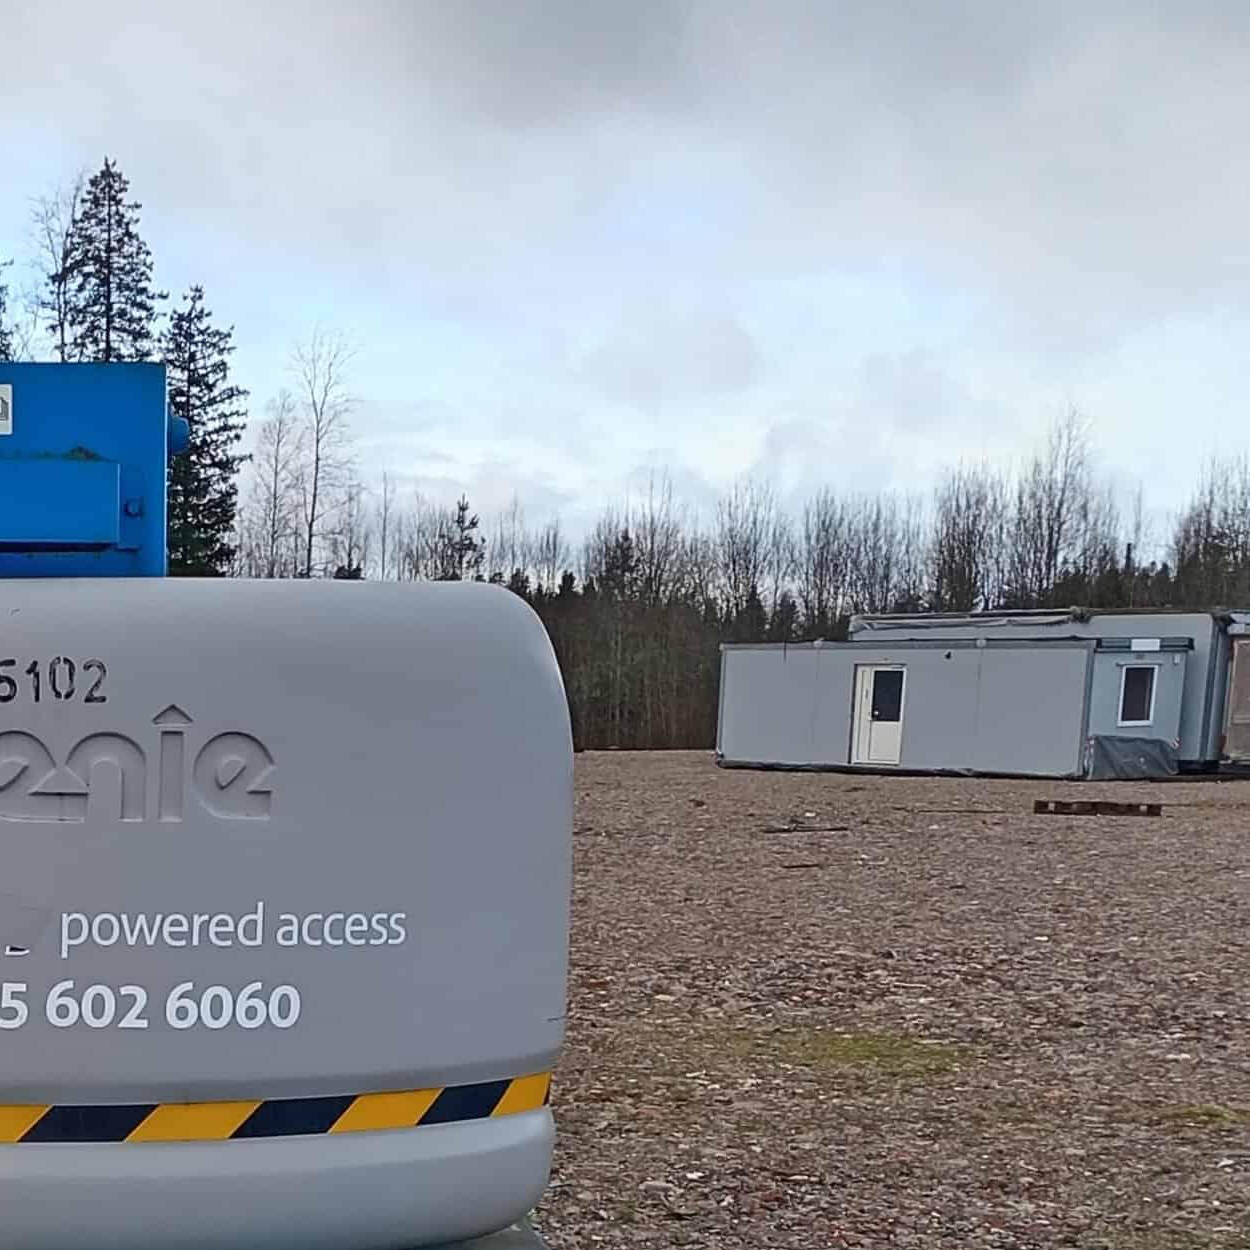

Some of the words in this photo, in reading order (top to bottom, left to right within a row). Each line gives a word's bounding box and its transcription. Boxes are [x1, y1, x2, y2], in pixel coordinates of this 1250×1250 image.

[59, 900, 265, 959] powered
[275, 912, 408, 947] access
[45, 979, 149, 1029] 602
[164, 981, 301, 1030] 6060
